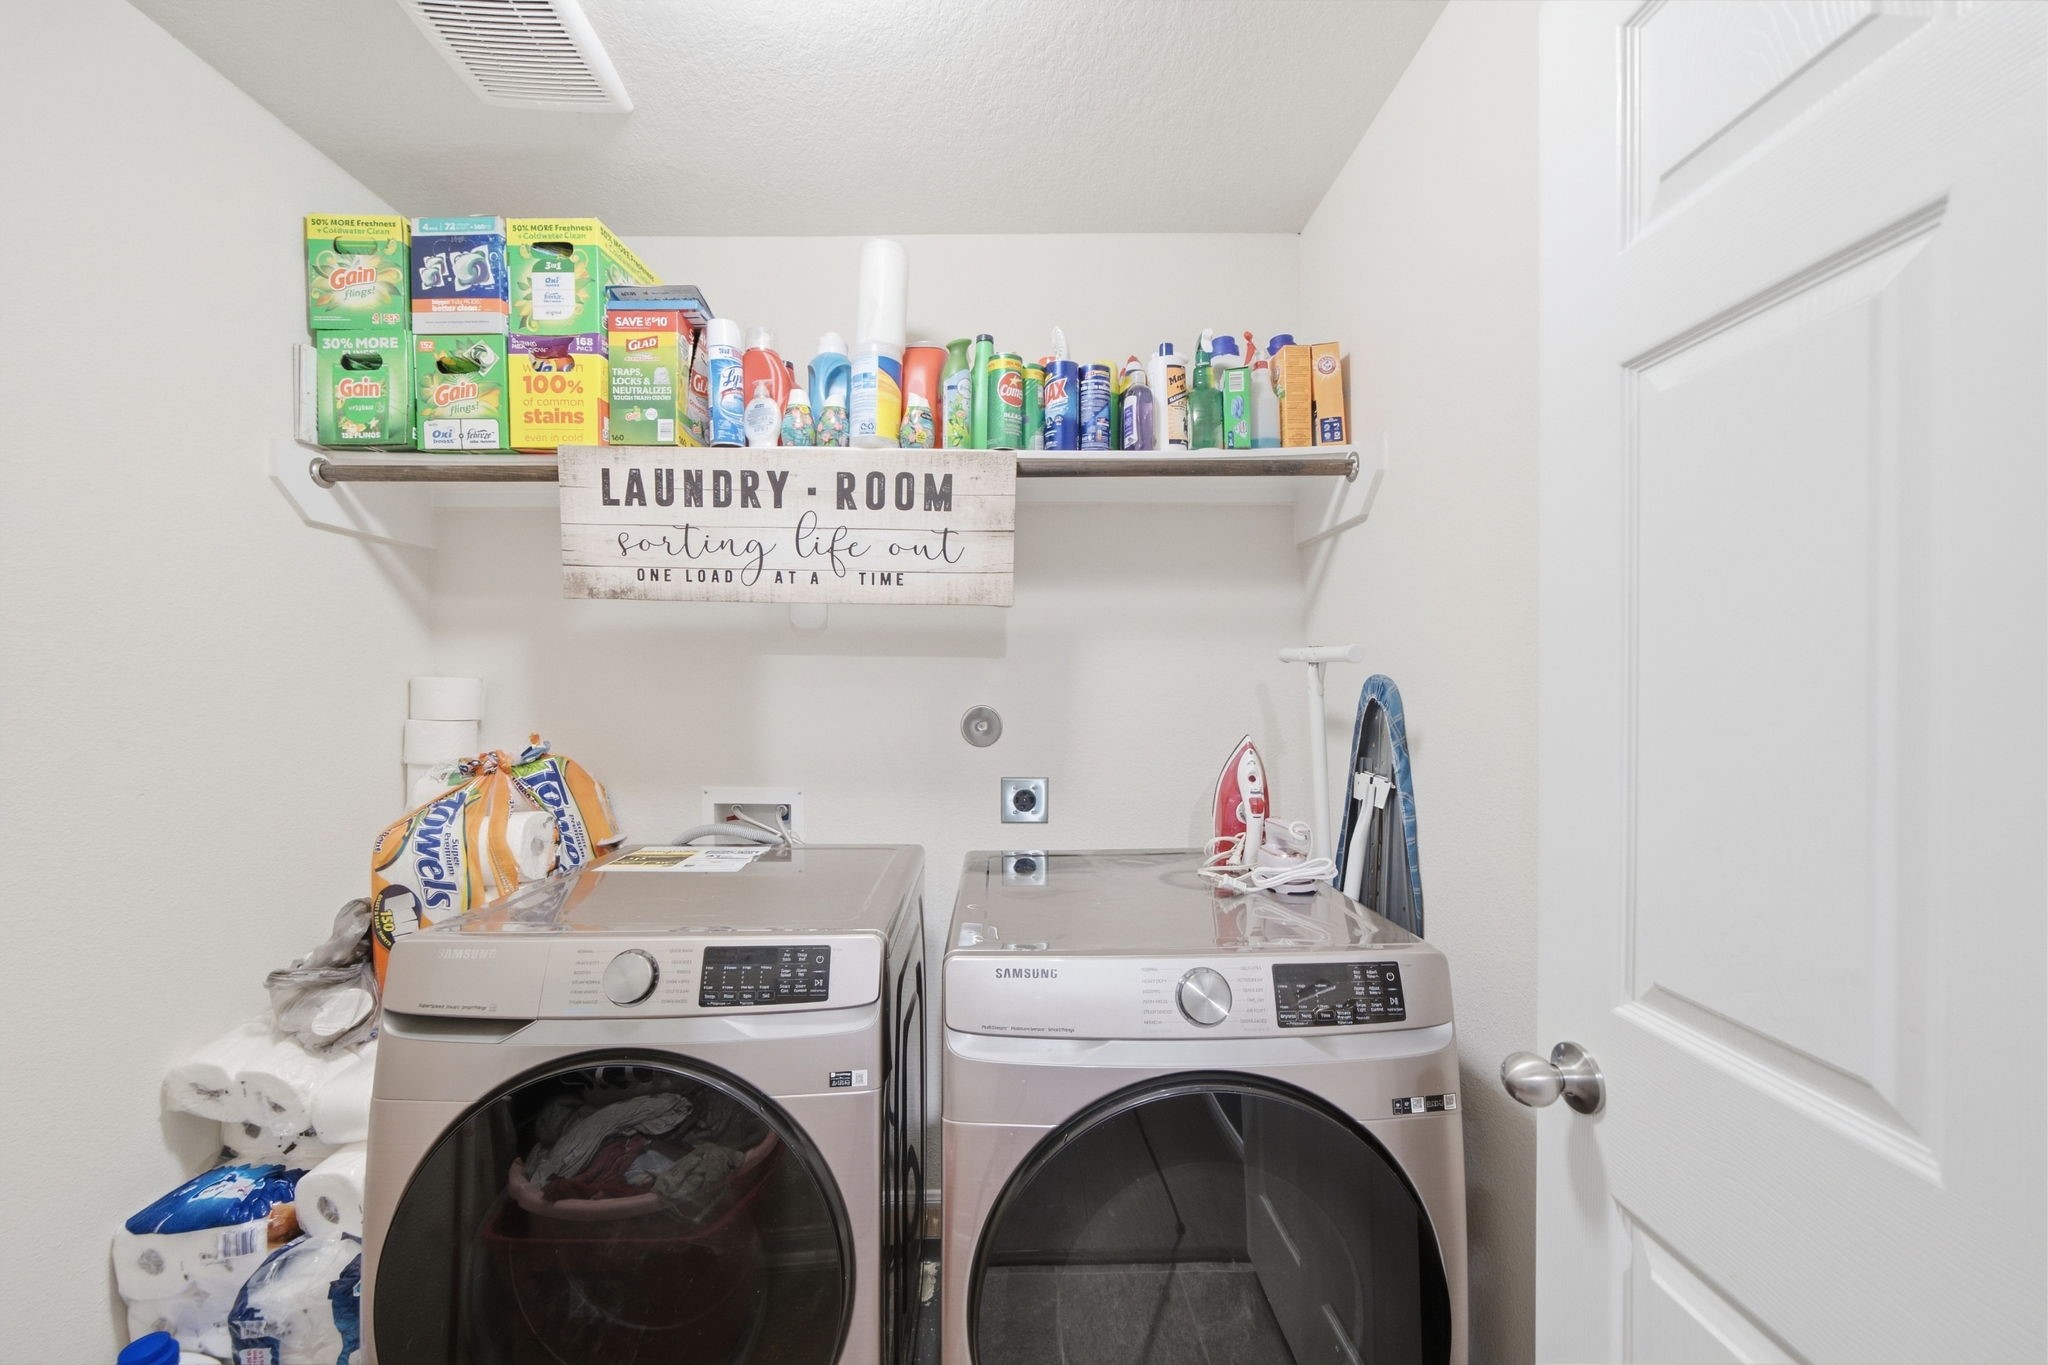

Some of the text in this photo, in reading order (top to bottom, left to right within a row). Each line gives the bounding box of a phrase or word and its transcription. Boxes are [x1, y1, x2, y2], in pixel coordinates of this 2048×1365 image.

[311, 218, 396, 228] 50% MORE Freshness
[512, 224, 593, 232] 50% MORE Freshness
[322, 226, 365, 234] Coldwater
[366, 227, 390, 235] Clean
[522, 232, 563, 240] Coldwater
[564, 231, 587, 239] Clean
[329, 266, 376, 291] Gain
[343, 285, 376, 301] flings!
[615, 316, 643, 327] SAVE
[651, 316, 668, 327] $10
[322, 336, 399, 349] 30% MORE
[575, 337, 593, 346] 168
[628, 338, 657, 351] GLAD
[612, 367, 643, 377] TRAPS,
[338, 376, 382, 399] Gain
[522, 374, 584, 394] 100%
[612, 377, 650, 385] LOCKS &
[433, 381, 478, 407] Gain
[612, 386, 672, 394] NEUTRALIZES
[1000, 384, 1023, 400] Come
[449, 400, 480, 416] flings!
[522, 397, 584, 407] of common
[523, 408, 585, 424] stains
[432, 429, 453, 438] Oxi
[524, 433, 584, 442] even in cold
[600, 467, 953, 512] LAUNDRY ROOM
[617, 510, 965, 587] sorting life out
[637, 567, 905, 586] ONE LOAD AT A TIME
[413, 790, 468, 910] Towels
[444, 832, 455, 876] Premium
[450, 838, 460, 867] Super
[380, 909, 395, 933] 150
[438, 948, 497, 960] SAMSUNG
[995, 967, 1058, 979] SAMSUNG
